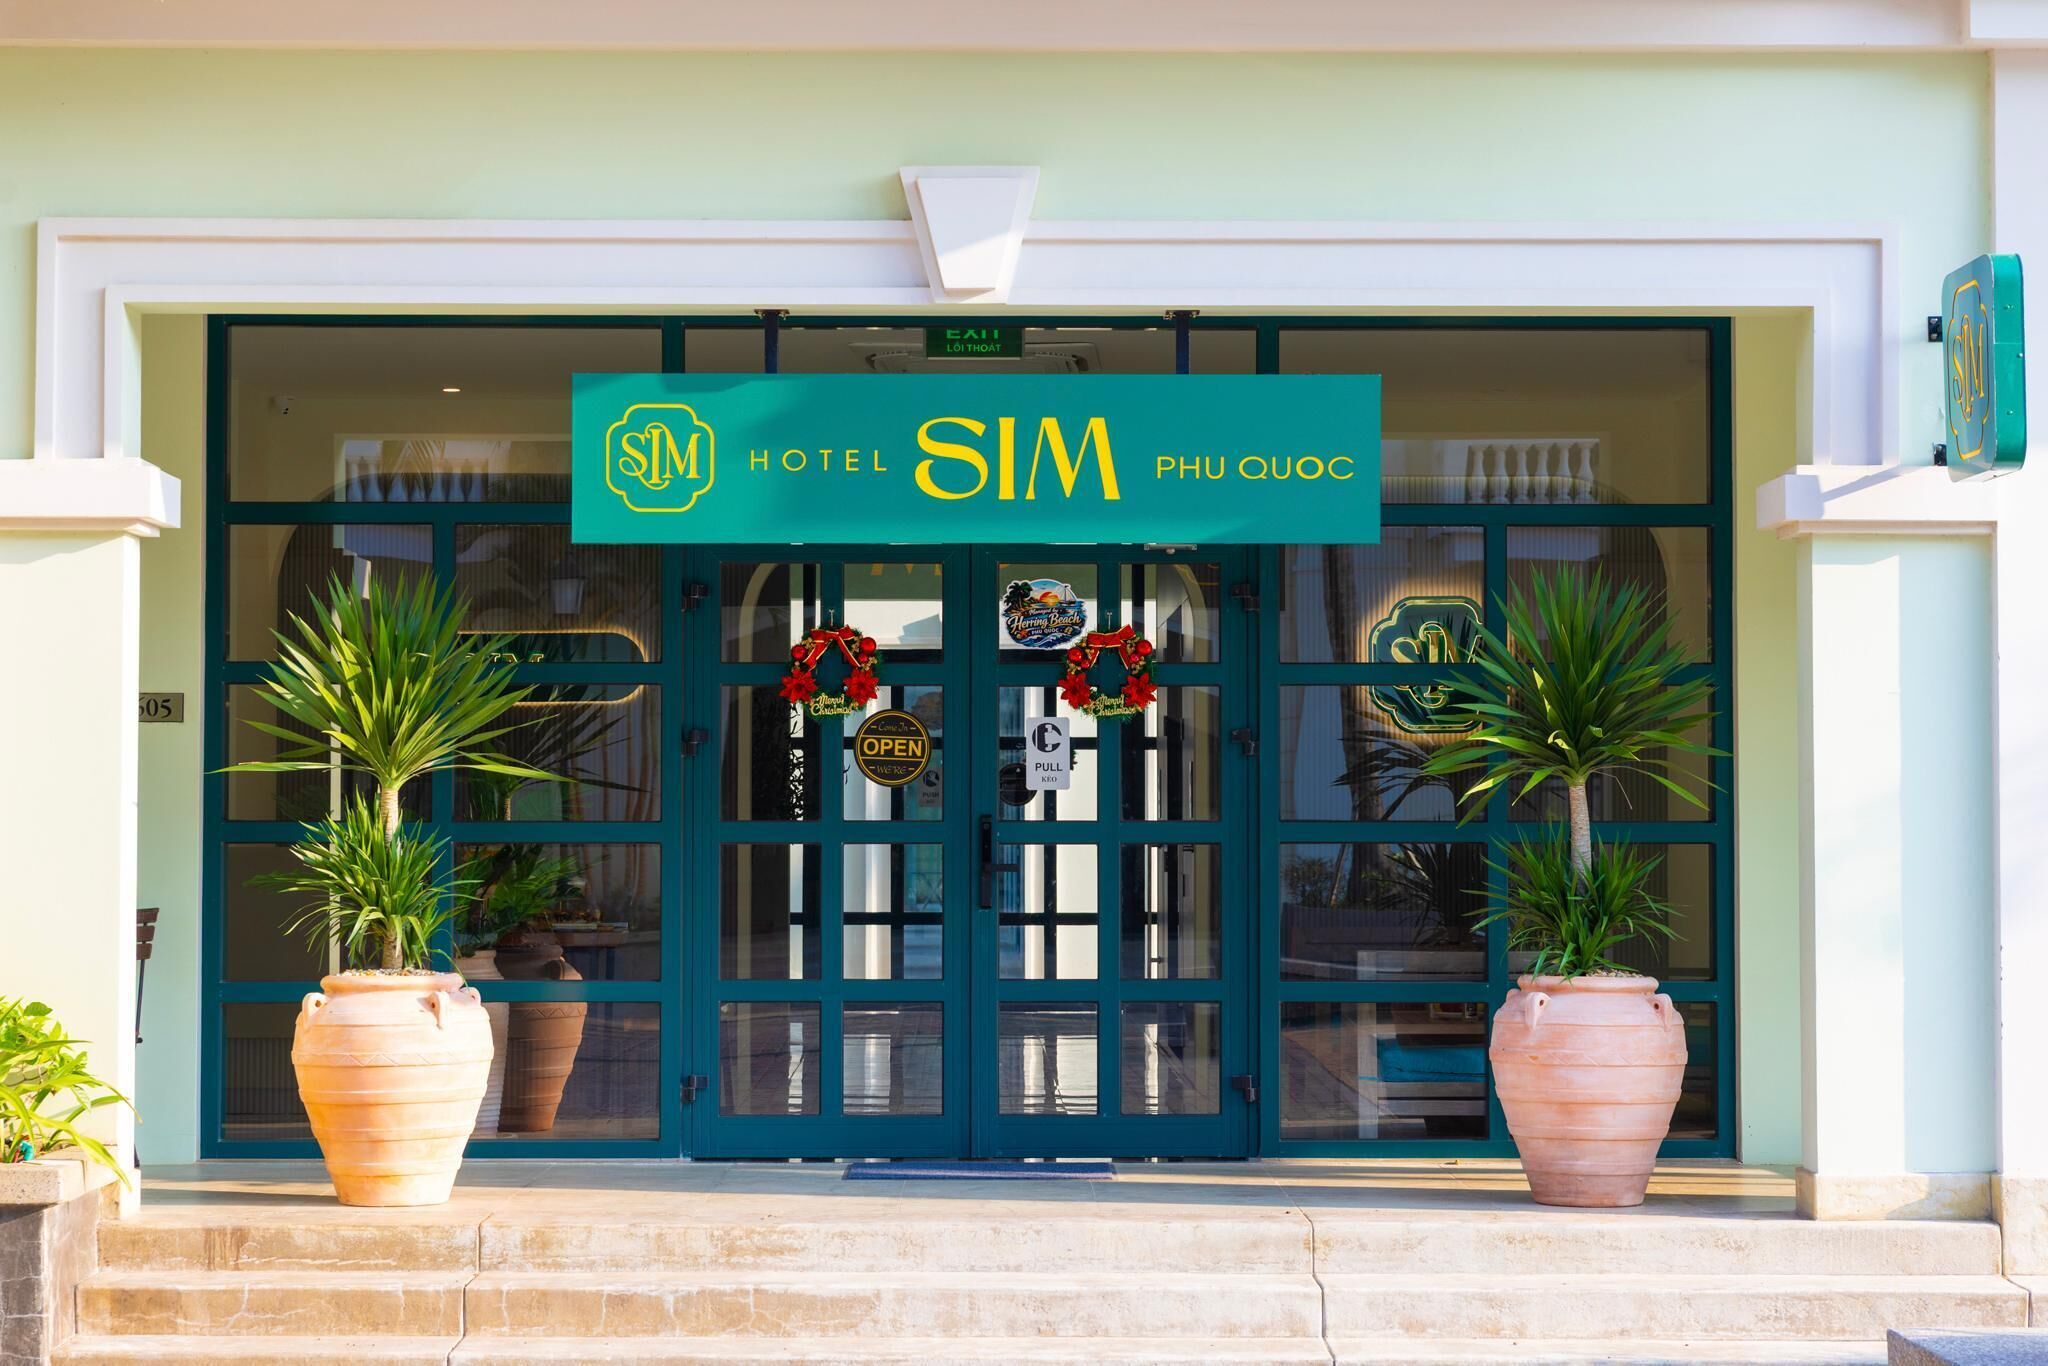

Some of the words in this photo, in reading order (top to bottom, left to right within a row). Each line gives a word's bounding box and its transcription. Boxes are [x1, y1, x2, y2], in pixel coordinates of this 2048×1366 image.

[618, 421, 702, 491] SIM
[749, 449, 888, 472] HOTEL
[914, 416, 1121, 501] SIM
[1157, 456, 1226, 480] PHU
[1237, 456, 1355, 480] QUOC
[1008, 615, 1049, 634] Herring
[1048, 611, 1082, 628] Beach
[863, 738, 922, 757] OPEN
[1035, 762, 1063, 772] PULL
